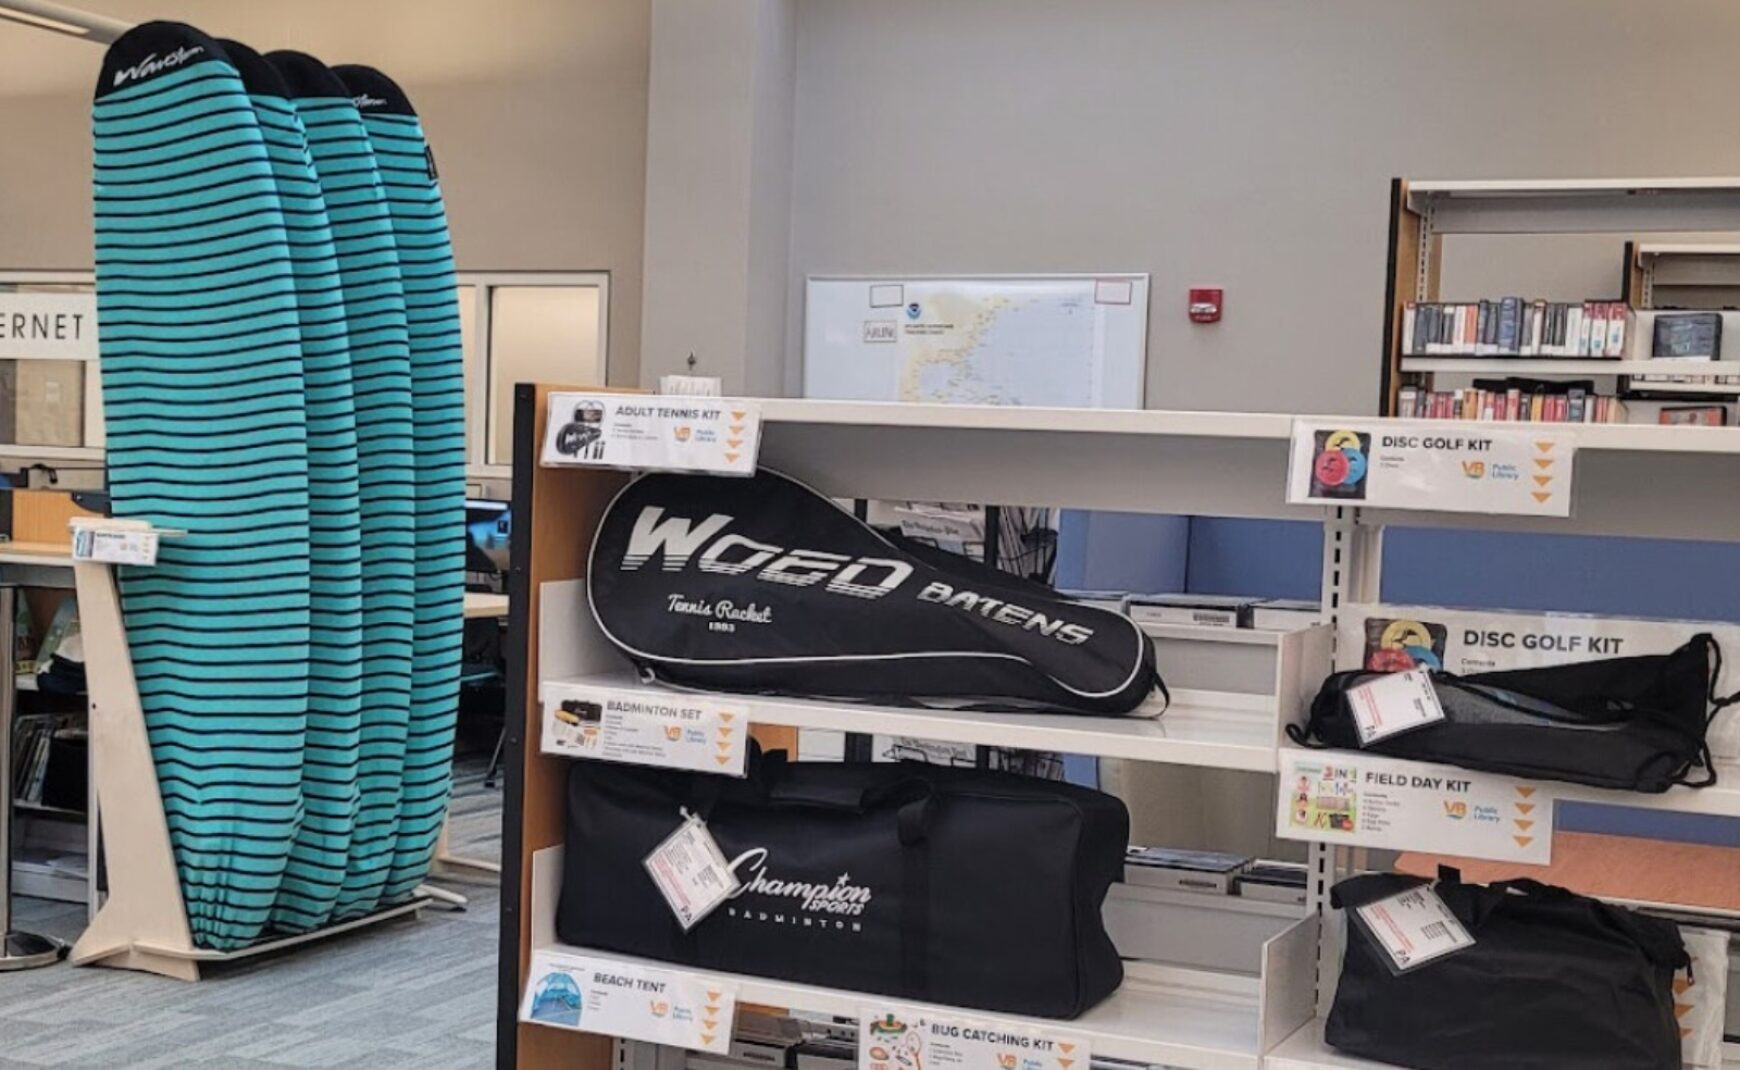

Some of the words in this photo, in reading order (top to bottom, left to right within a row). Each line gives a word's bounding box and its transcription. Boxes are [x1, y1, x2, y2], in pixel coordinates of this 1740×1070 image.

[615, 405, 654, 417] ADULT
[657, 407, 699, 419] TENNIS
[701, 410, 721, 420] KIT
[1382, 435, 1419, 449] DISC
[1422, 437, 1463, 451] GOLF
[1468, 439, 1493, 451] KIT
[668, 594, 713, 616] Tennis
[715, 600, 772, 623] Racket
[917, 582, 1094, 644] BATENS
[1463, 630, 1515, 648] DISC
[1522, 634, 1582, 652] GOLF
[1587, 637, 1624, 654] KIT
[606, 700, 677, 718] BADMINTON
[680, 709, 702, 720] SET
[1365, 772, 1407, 786] FIELD
[1411, 776, 1443, 790] DAY
[1446, 779, 1472, 792] KIT
[1443, 800, 1467, 818] VB
[1473, 812, 1501, 824] Library
[1474, 805, 1498, 815] Public
[727, 847, 871, 910] Champion
[808, 899, 865, 915] SPORTS
[728, 906, 862, 932] BADMINTON
[594, 972, 634, 989] BEACH
[636, 979, 666, 993] TENT
[931, 1022, 959, 1038] BUG
[962, 1028, 1030, 1049] CATCHING
[1033, 1039, 1054, 1051] KIT
